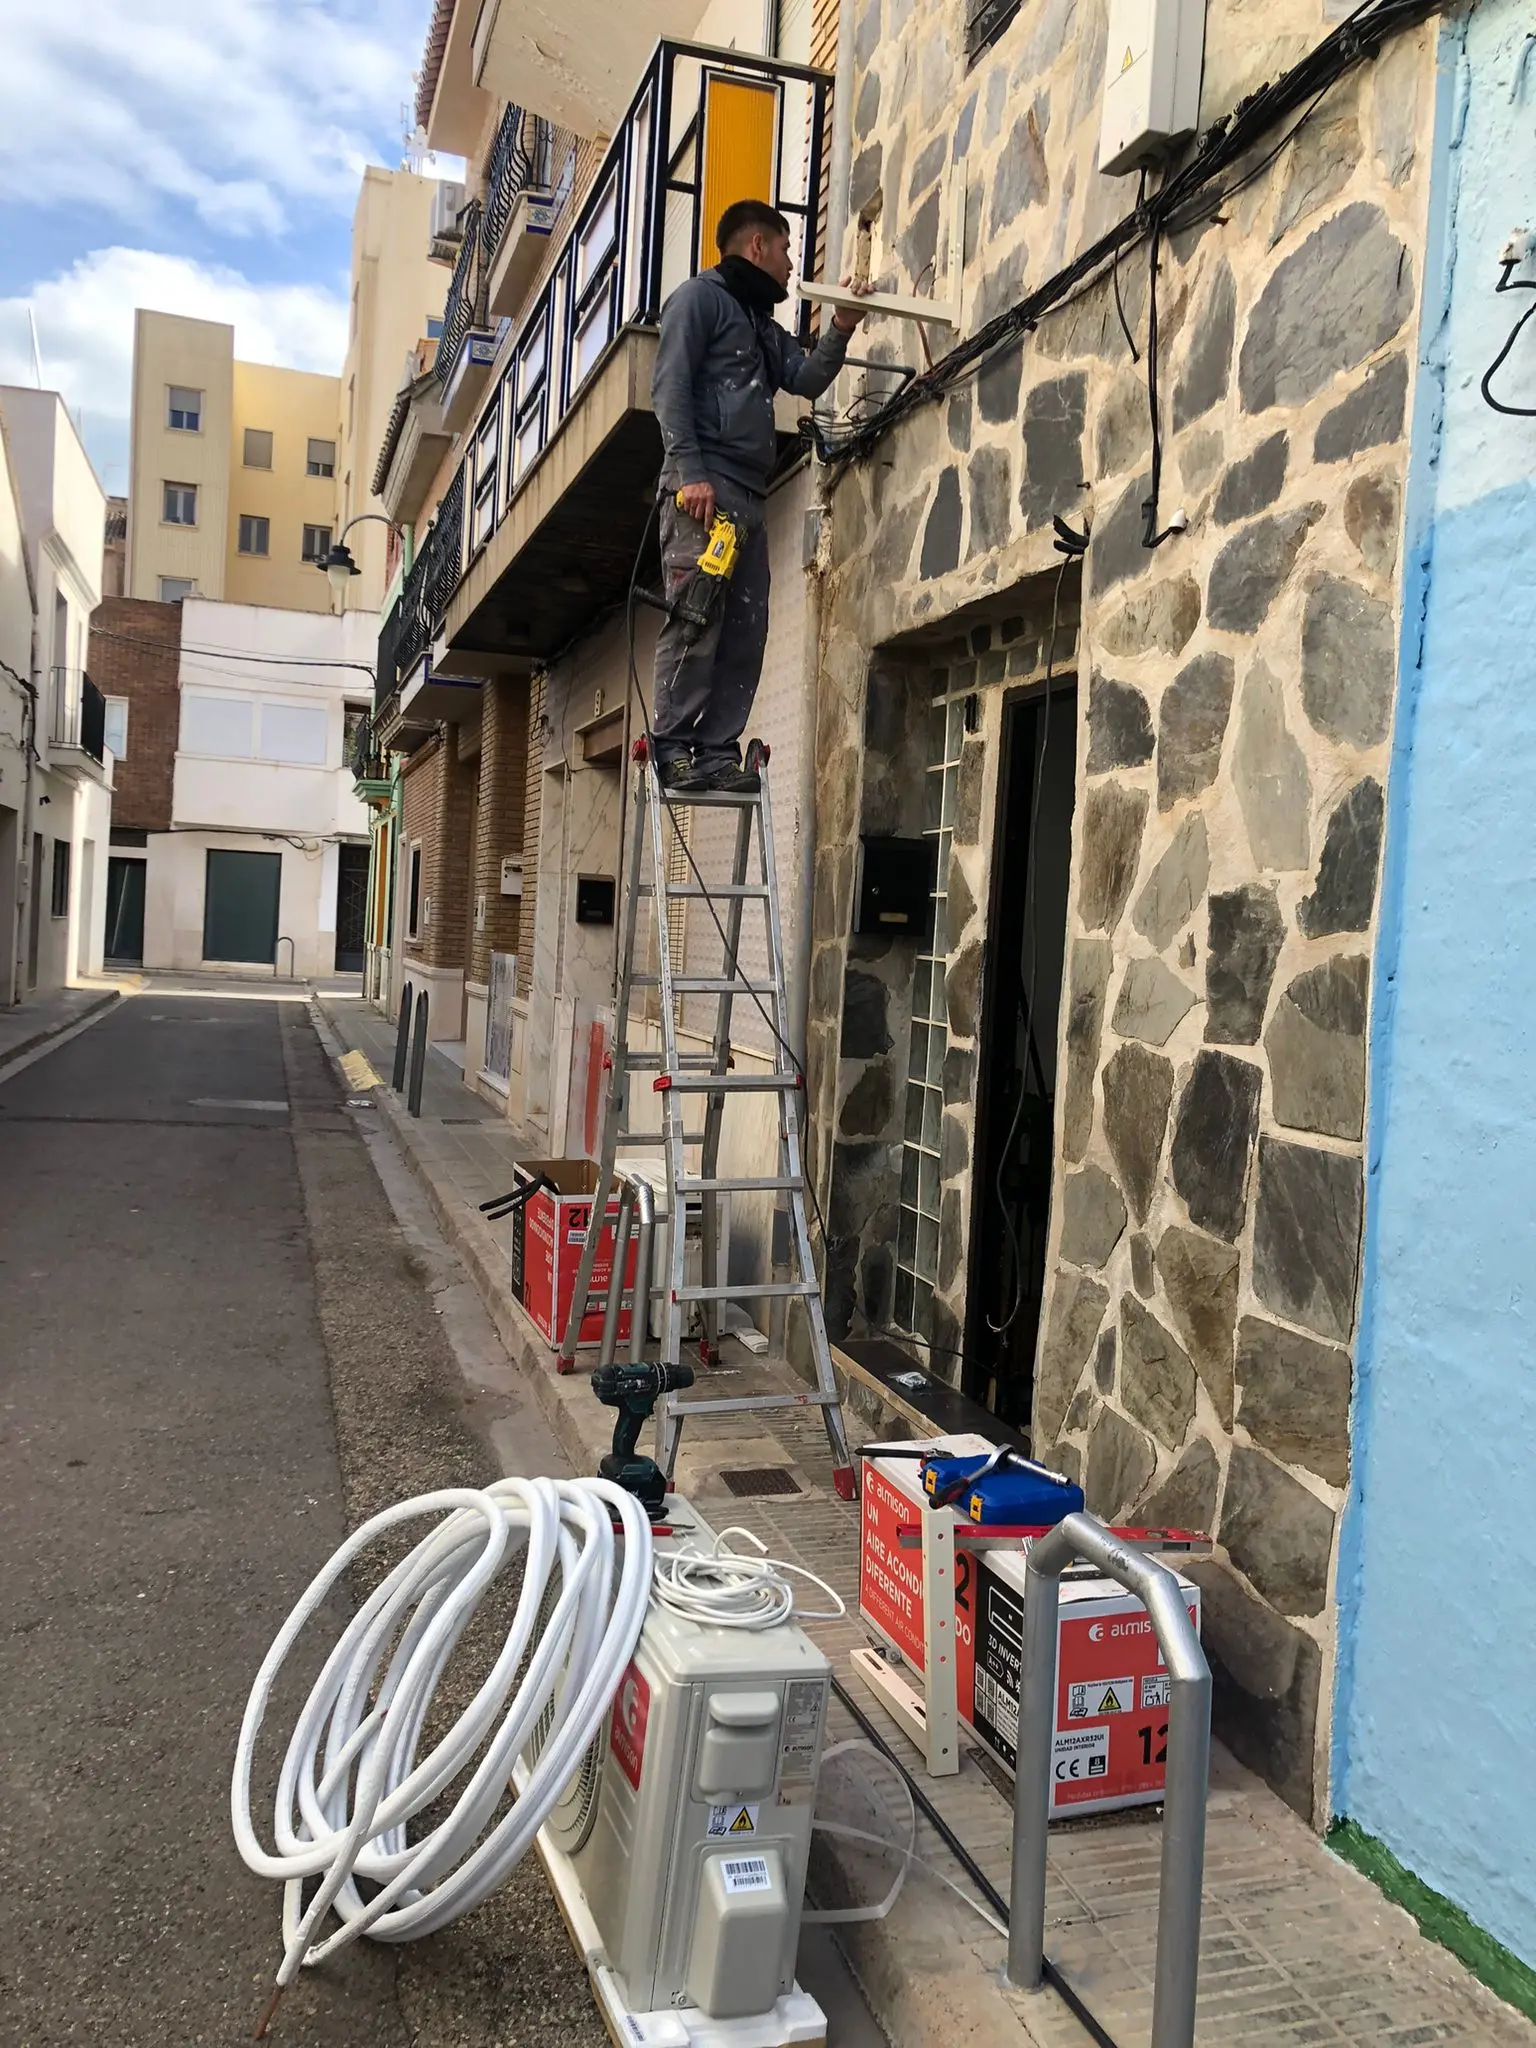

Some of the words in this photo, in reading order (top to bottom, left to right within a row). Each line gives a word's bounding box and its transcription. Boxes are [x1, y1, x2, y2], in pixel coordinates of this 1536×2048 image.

[867, 1499, 879, 1527] UN
[876, 1483, 910, 1523] almison
[866, 1531, 885, 1561] AIRE
[865, 1555, 912, 1619] DIFERENTE
[955, 1552, 970, 1612] 2
[868, 1587, 895, 1623] DIFFERENT
[1110, 1620, 1153, 1637] almis
[999, 1643, 1021, 1673] INVER
